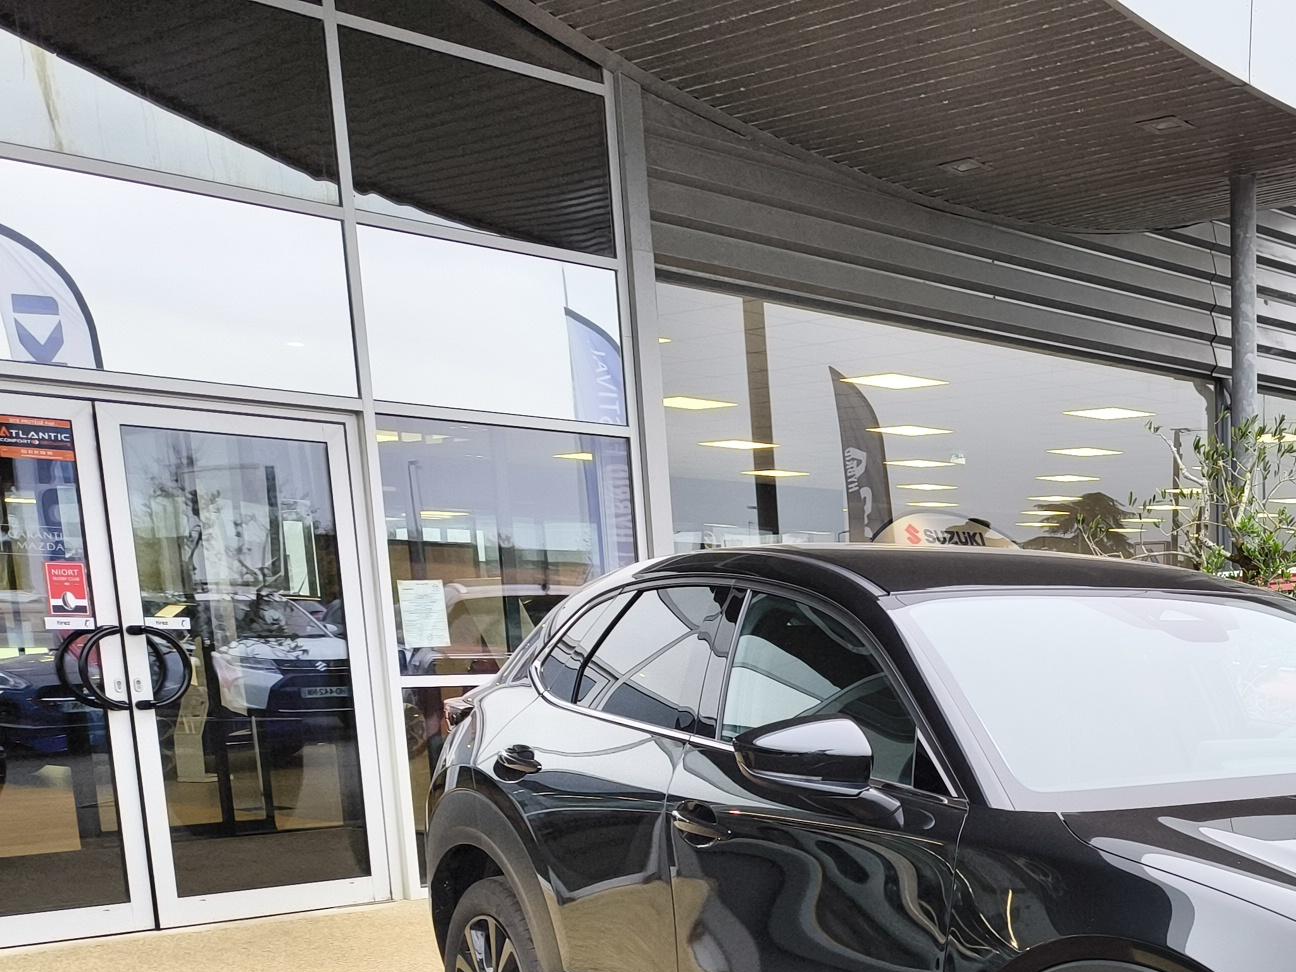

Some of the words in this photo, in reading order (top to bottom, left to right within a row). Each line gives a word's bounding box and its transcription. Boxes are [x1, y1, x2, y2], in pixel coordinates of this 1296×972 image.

[0, 426, 70, 441] ATLANTIC
[923, 528, 986, 547] SUZUKI
[16, 541, 64, 552] MAZDA
